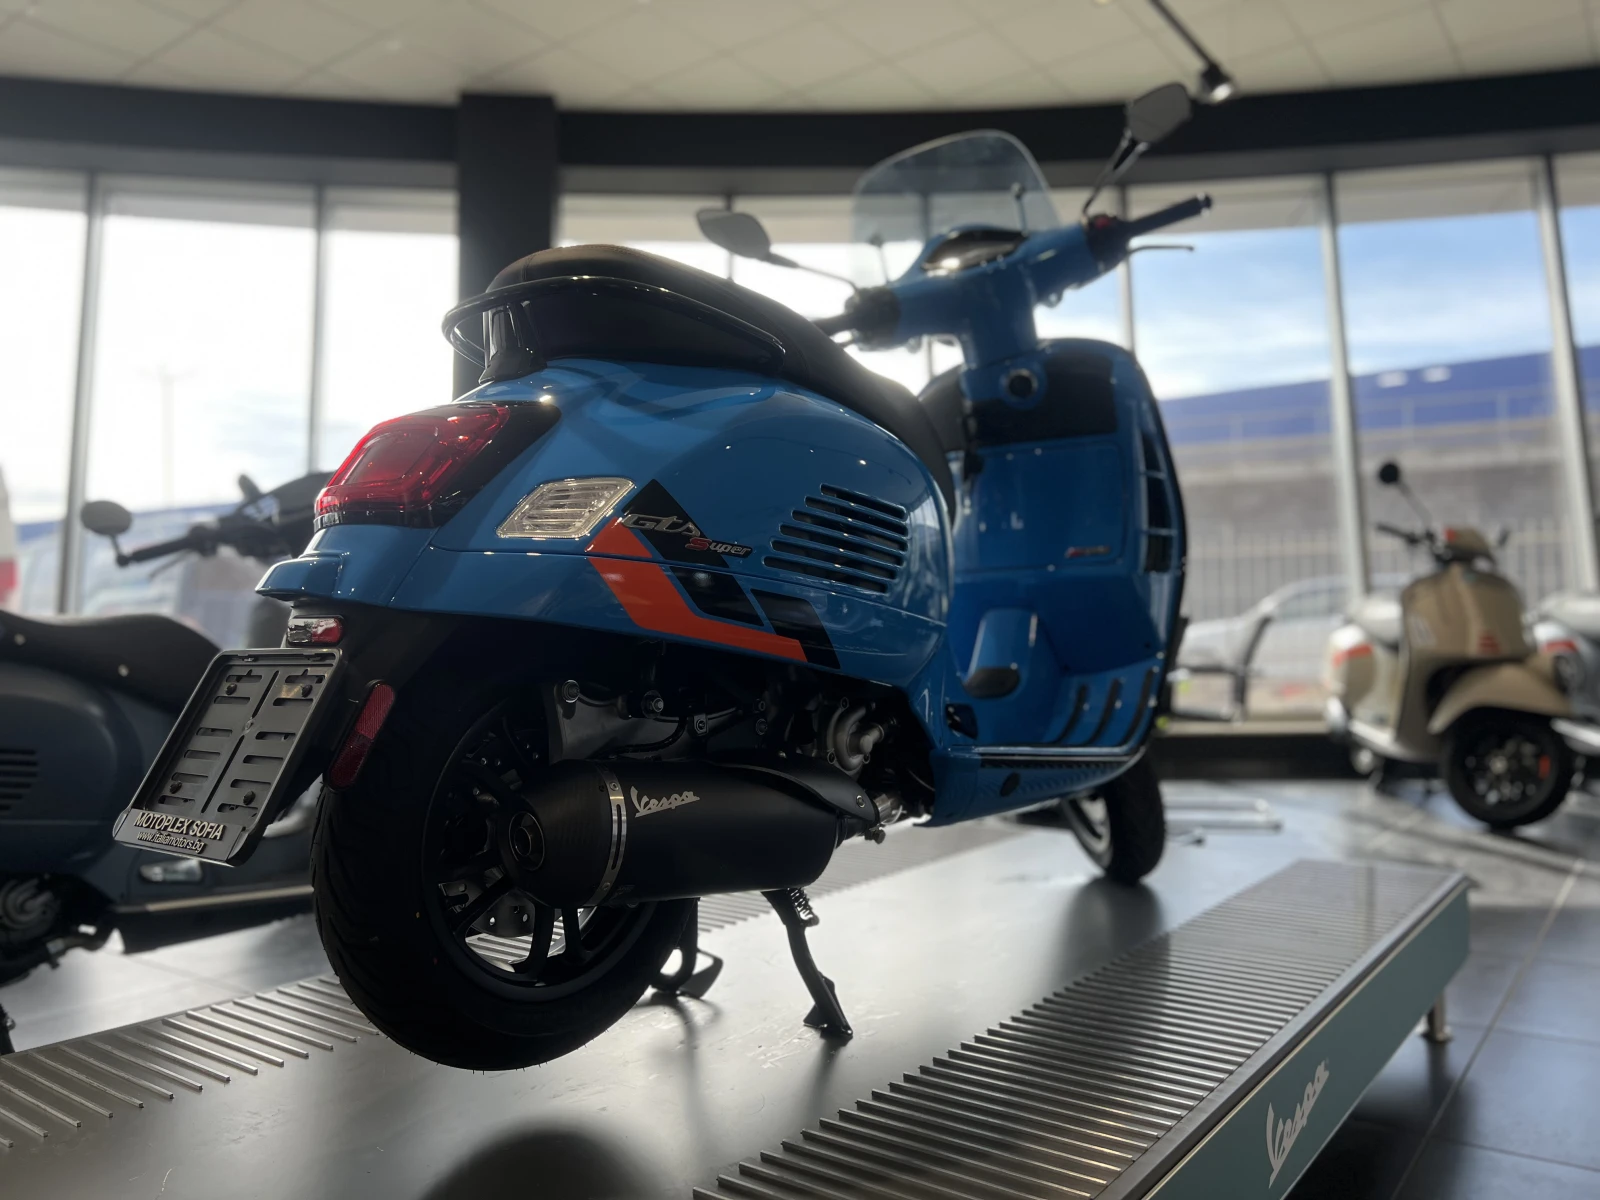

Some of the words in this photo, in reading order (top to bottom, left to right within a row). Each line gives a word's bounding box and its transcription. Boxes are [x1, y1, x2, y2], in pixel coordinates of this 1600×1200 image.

[685, 537, 752, 556] Super
[630, 786, 700, 817] Vespa
[134, 812, 192, 835] MOTOPLEX
[190, 820, 225, 840] SOFIA
[136, 831, 205, 853] www.italiamotors.bg
[1266, 1058, 1330, 1189] Vespa
